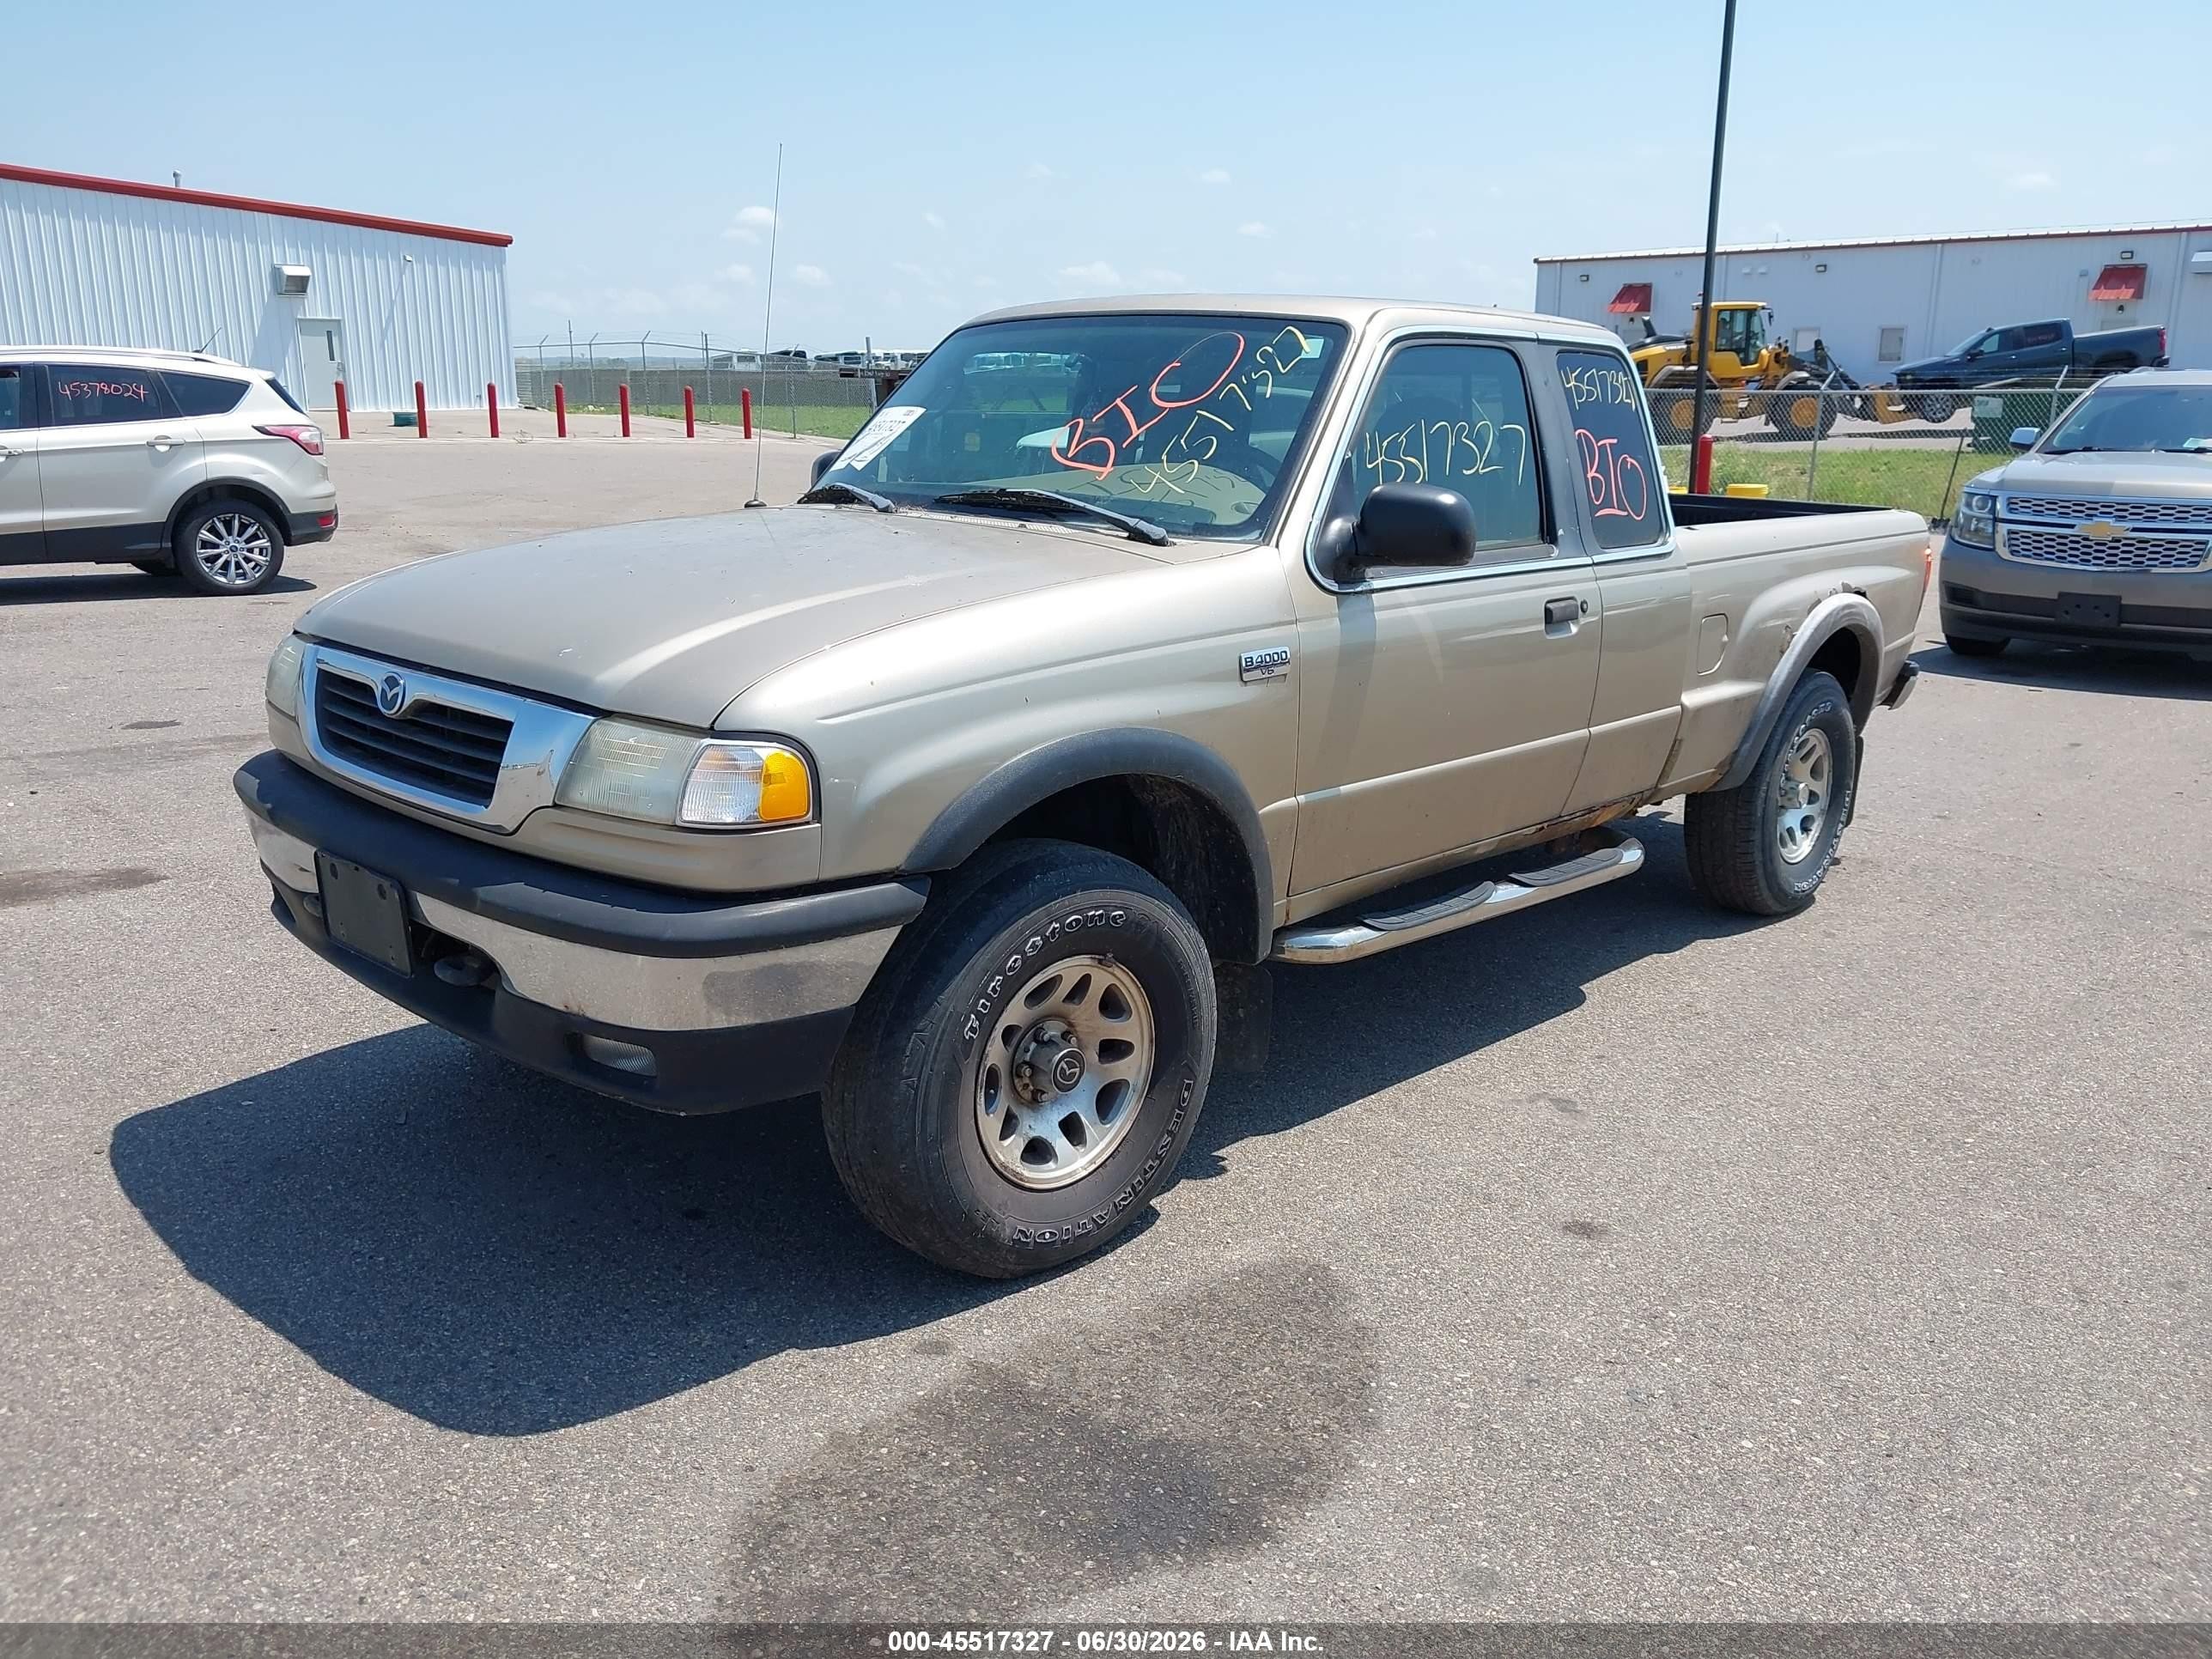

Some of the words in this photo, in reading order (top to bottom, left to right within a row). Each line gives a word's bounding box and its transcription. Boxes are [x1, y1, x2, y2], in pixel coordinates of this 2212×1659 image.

[57, 380, 149, 404] 45378024
[1050, 331, 1245, 481] BIO
[1364, 418, 1526, 486] 45517327
[1574, 428, 1648, 520] BIO
[1243, 650, 1289, 667] B4000
[1012, 1078, 1194, 1243] DESTINATION
